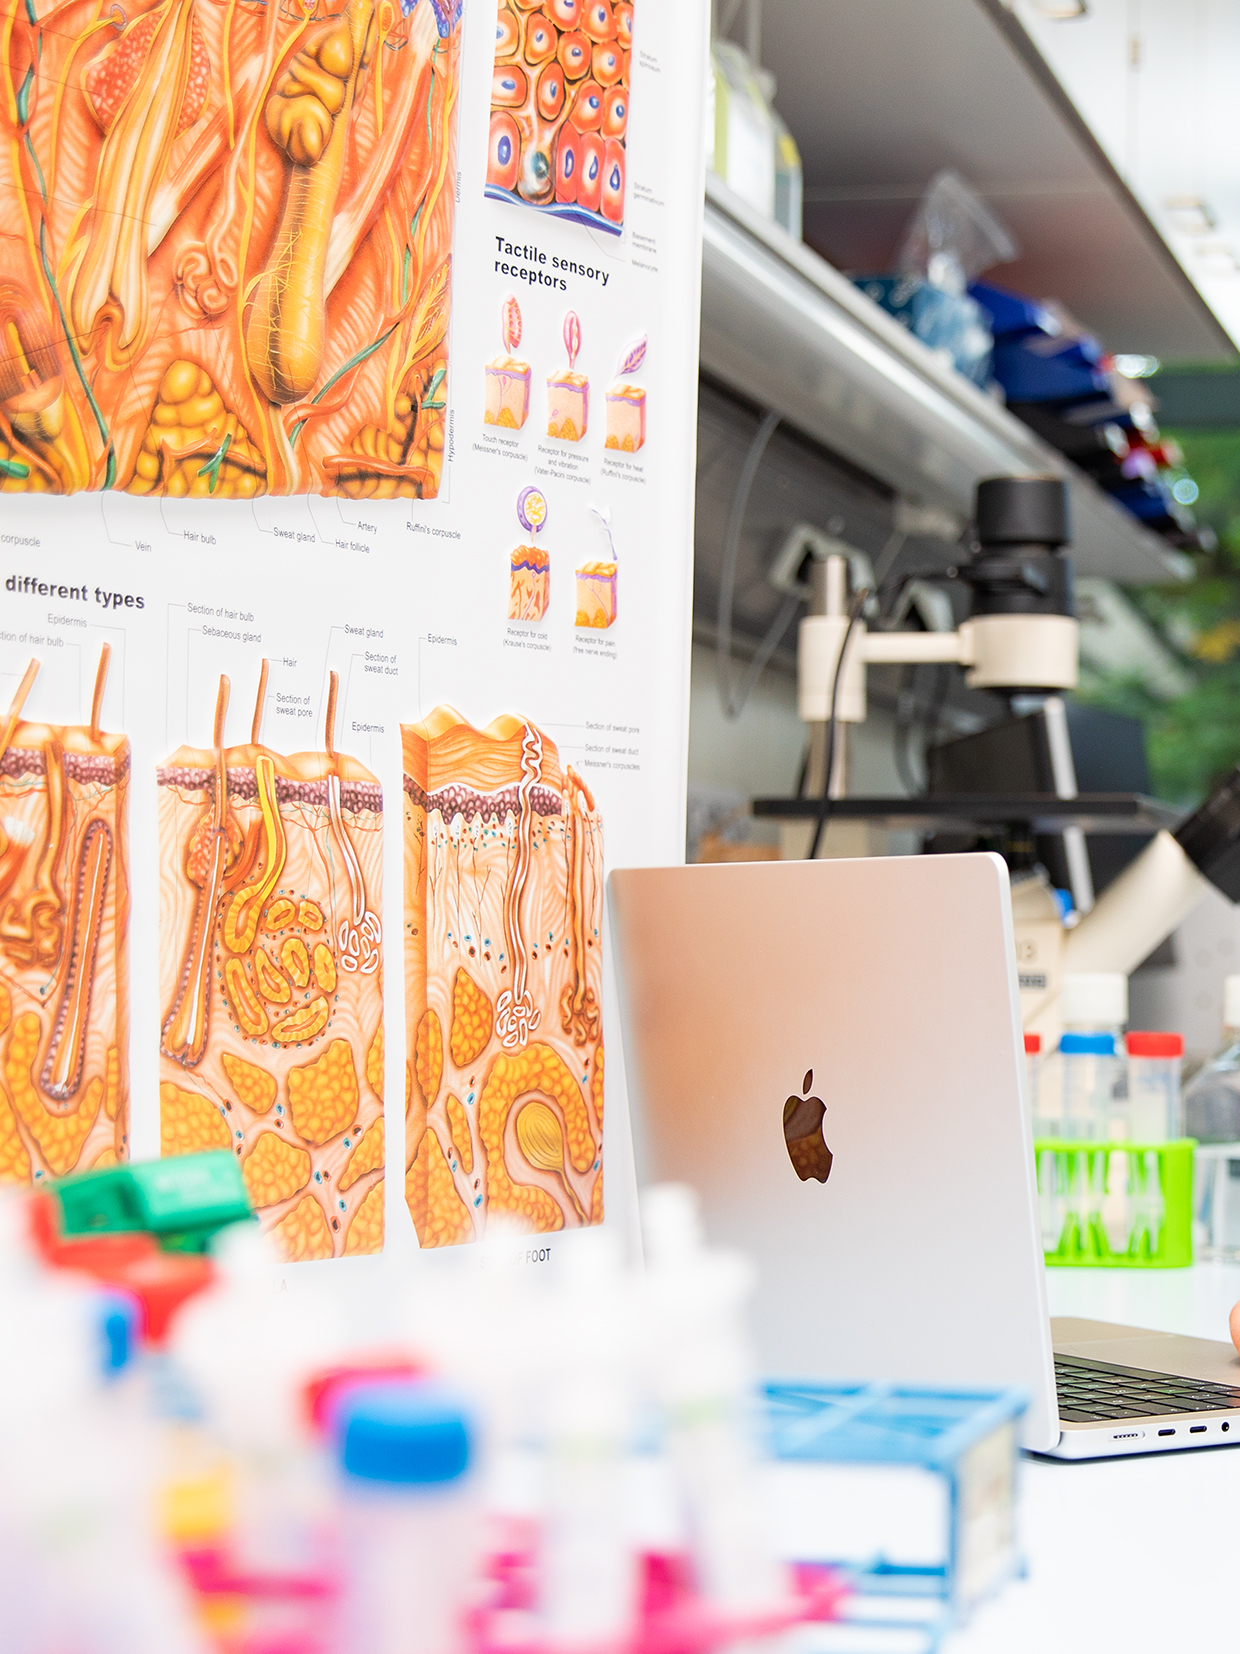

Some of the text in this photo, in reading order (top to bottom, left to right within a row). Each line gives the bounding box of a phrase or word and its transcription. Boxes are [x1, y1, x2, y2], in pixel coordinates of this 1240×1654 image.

[495, 235, 610, 287] Tactile sensory
[494, 260, 567, 291] receptors
[447, 409, 456, 463] Hypodermis
[482, 433, 519, 448] Touch receptor
[472, 442, 529, 462] (Meissner's corpuscle)
[537, 444, 560, 456] Receptor
[568, 453, 589, 463] pressure
[548, 458, 579, 471] and vibration
[604, 457, 625, 469] Receptor
[357, 521, 377, 534] Artery
[406, 521, 461, 540] Ruffini's corpuscle
[0, 533, 41, 548] corpuscle
[183, 530, 217, 546] Hair bulb
[273, 527, 316, 544] Sweat gland
[135, 540, 152, 553] Vein
[335, 538, 370, 553] Hair follicle
[5, 575, 146, 609] different types
[187, 602, 254, 623] Section of hair bulb
[47, 613, 88, 628] Epidermis
[0, 630, 64, 647] tion of hair bulb
[202, 625, 262, 644] Sebaceous gland
[344, 624, 383, 639] Sweat gland
[507, 627, 529, 638] Receptor
[538, 632, 548, 640] cold
[427, 633, 458, 646] Epidermis
[575, 634, 597, 645] Receptor
[605, 640, 615, 648] pain
[527, 642, 551, 652] corpuscle)
[585, 648, 598, 656] nerve
[283, 656, 297, 668] Hair
[365, 650, 397, 664] Section of
[364, 663, 398, 676] sweat duct
[276, 692, 310, 705] Section of
[276, 705, 313, 719] sweat pore
[352, 721, 385, 734] Epidermis
[585, 721, 605, 731] Section
[613, 725, 627, 733] sweat
[585, 743, 604, 752] Section
[612, 747, 626, 755] sweat
[628, 748, 639, 756] duct
[584, 759, 611, 768] Meissner's
[525, 1247, 552, 1264] FOOT
